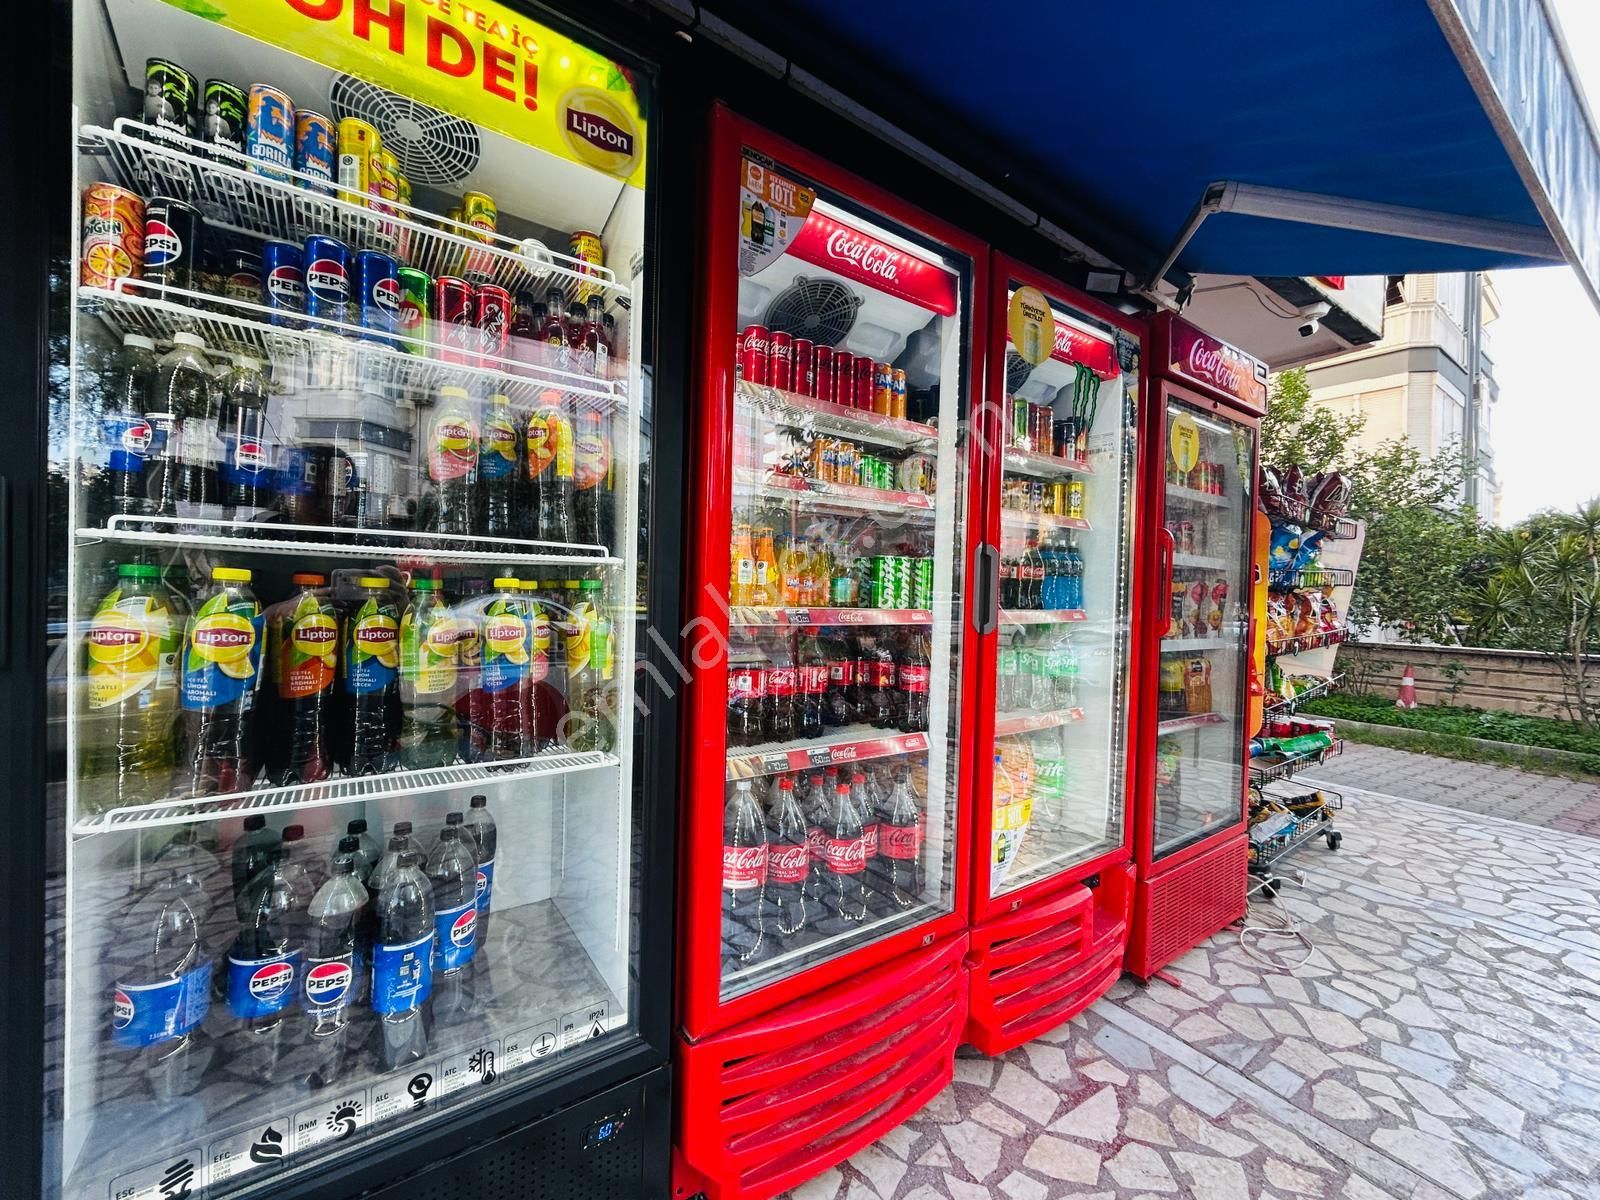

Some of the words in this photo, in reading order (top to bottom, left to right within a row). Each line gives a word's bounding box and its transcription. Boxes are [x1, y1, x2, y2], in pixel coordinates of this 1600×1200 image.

[458, 2, 507, 41] TEA
[511, 24, 539, 59] İÇ
[425, 14, 539, 113] DE!
[572, 112, 629, 152] Lipton
[251, 143, 293, 170] GORILLA
[826, 228, 897, 281] Coca-Cola
[1189, 338, 1241, 392] Coca-Cola
[198, 629, 249, 644] Lipton
[298, 628, 335, 641] Lipton
[358, 629, 395, 642] Lipton
[489, 626, 522, 639] Lipton
[252, 971, 292, 989] PEPSI
[588, 1008, 605, 1022] IP24
[506, 1043, 519, 1053] ESS
[444, 1066, 458, 1079] ATC
[375, 1092, 389, 1104] ALC
[298, 1118, 318, 1132] DNM
[213, 1150, 231, 1164] EFC
[115, 1186, 135, 1200] ESC
